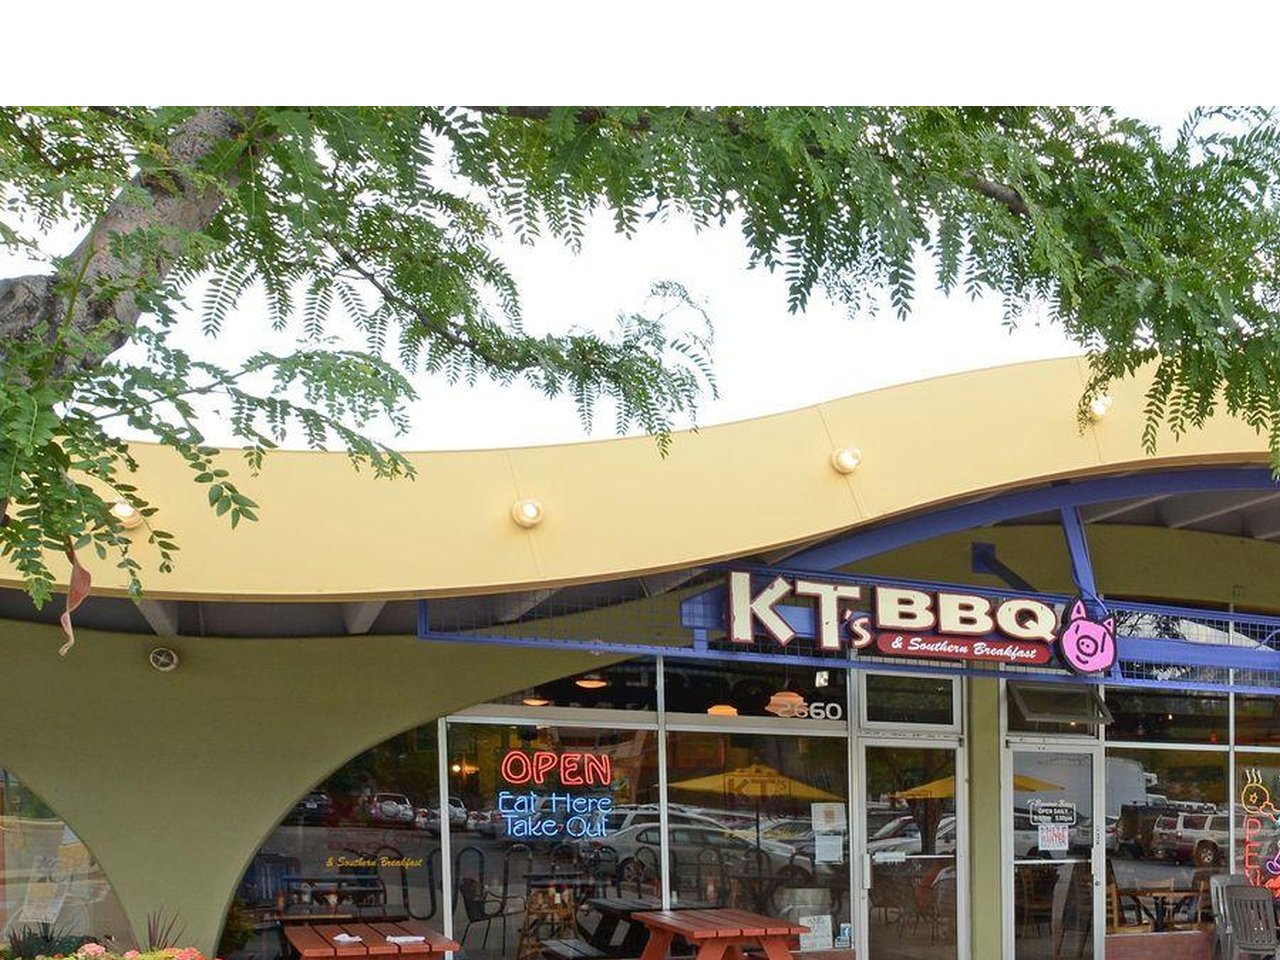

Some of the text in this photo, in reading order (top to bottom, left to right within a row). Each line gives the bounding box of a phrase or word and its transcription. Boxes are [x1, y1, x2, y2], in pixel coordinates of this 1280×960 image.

[874, 585, 1059, 642] BBQ
[891, 636, 1037, 661] & Southern Breakfast
[501, 750, 613, 786] OPEN
[498, 790, 613, 815] Eat Here
[501, 813, 609, 838] Take Out
